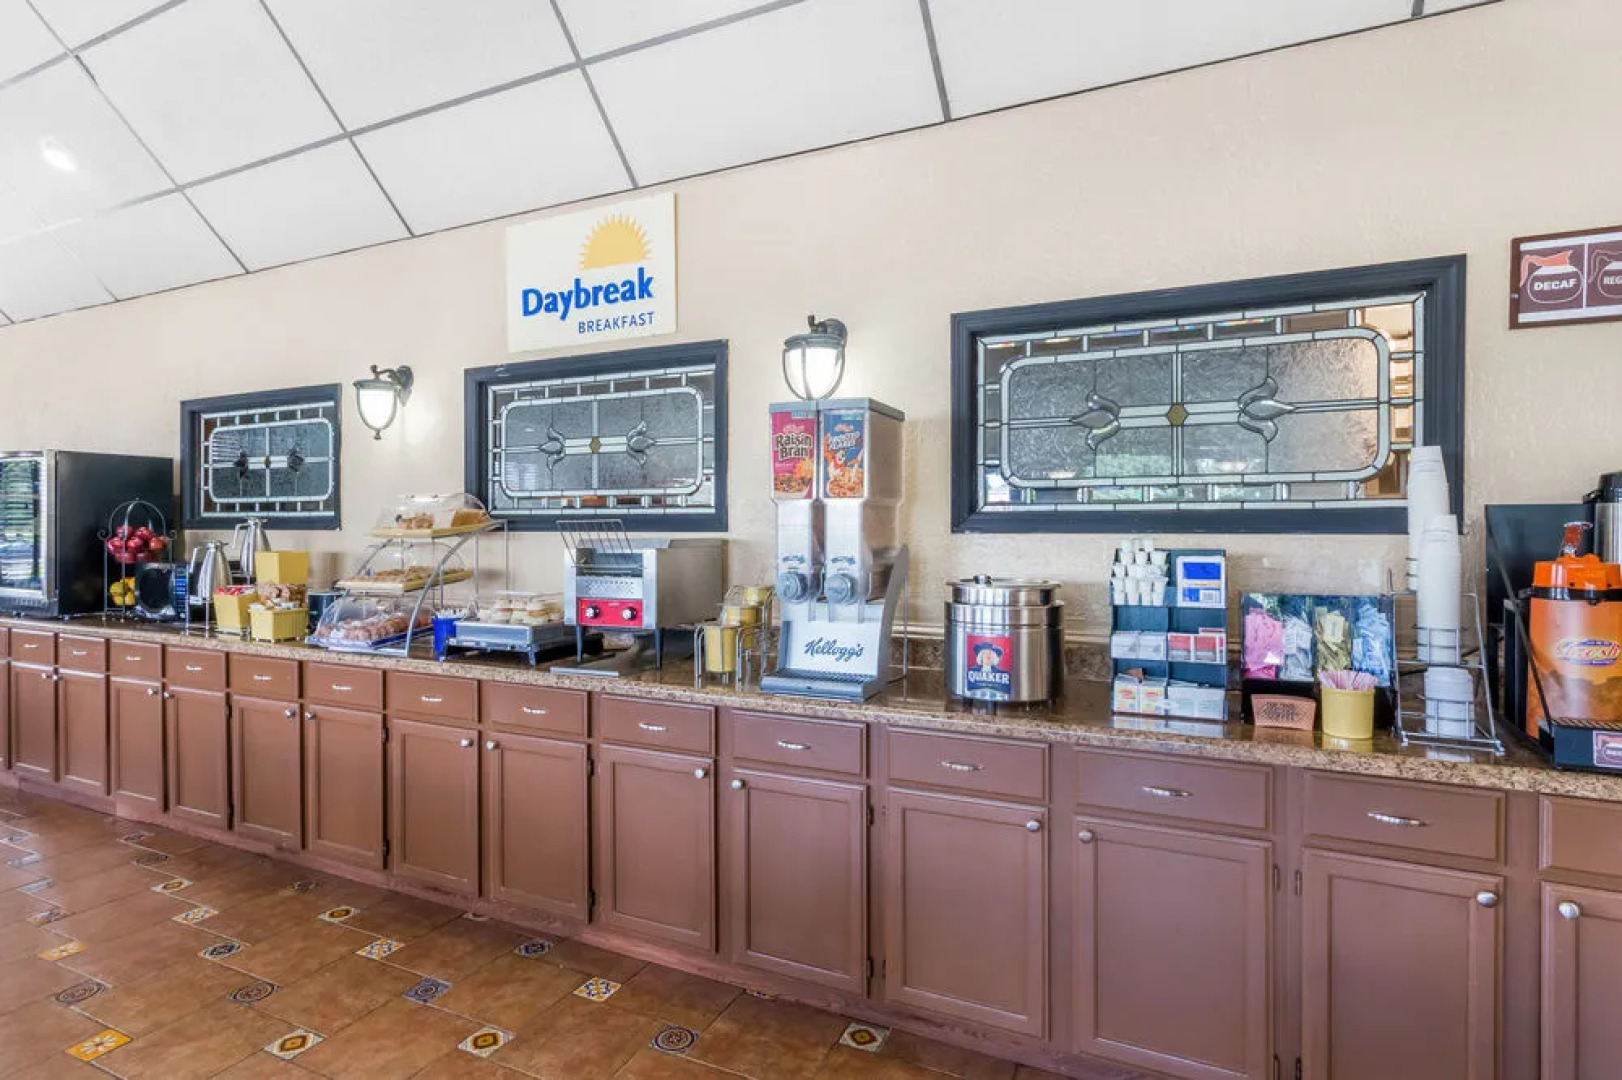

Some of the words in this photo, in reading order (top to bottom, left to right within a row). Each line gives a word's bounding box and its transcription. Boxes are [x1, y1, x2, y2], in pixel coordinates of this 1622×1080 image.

[1533, 278, 1577, 291] DECAF
[521, 267, 654, 321] Daybreak
[578, 311, 655, 334] BREAKFAST
[775, 434, 812, 449] Raisin
[779, 446, 809, 460] Bran
[804, 637, 864, 662] Kellogg's
[967, 670, 1010, 684] QUAKER
